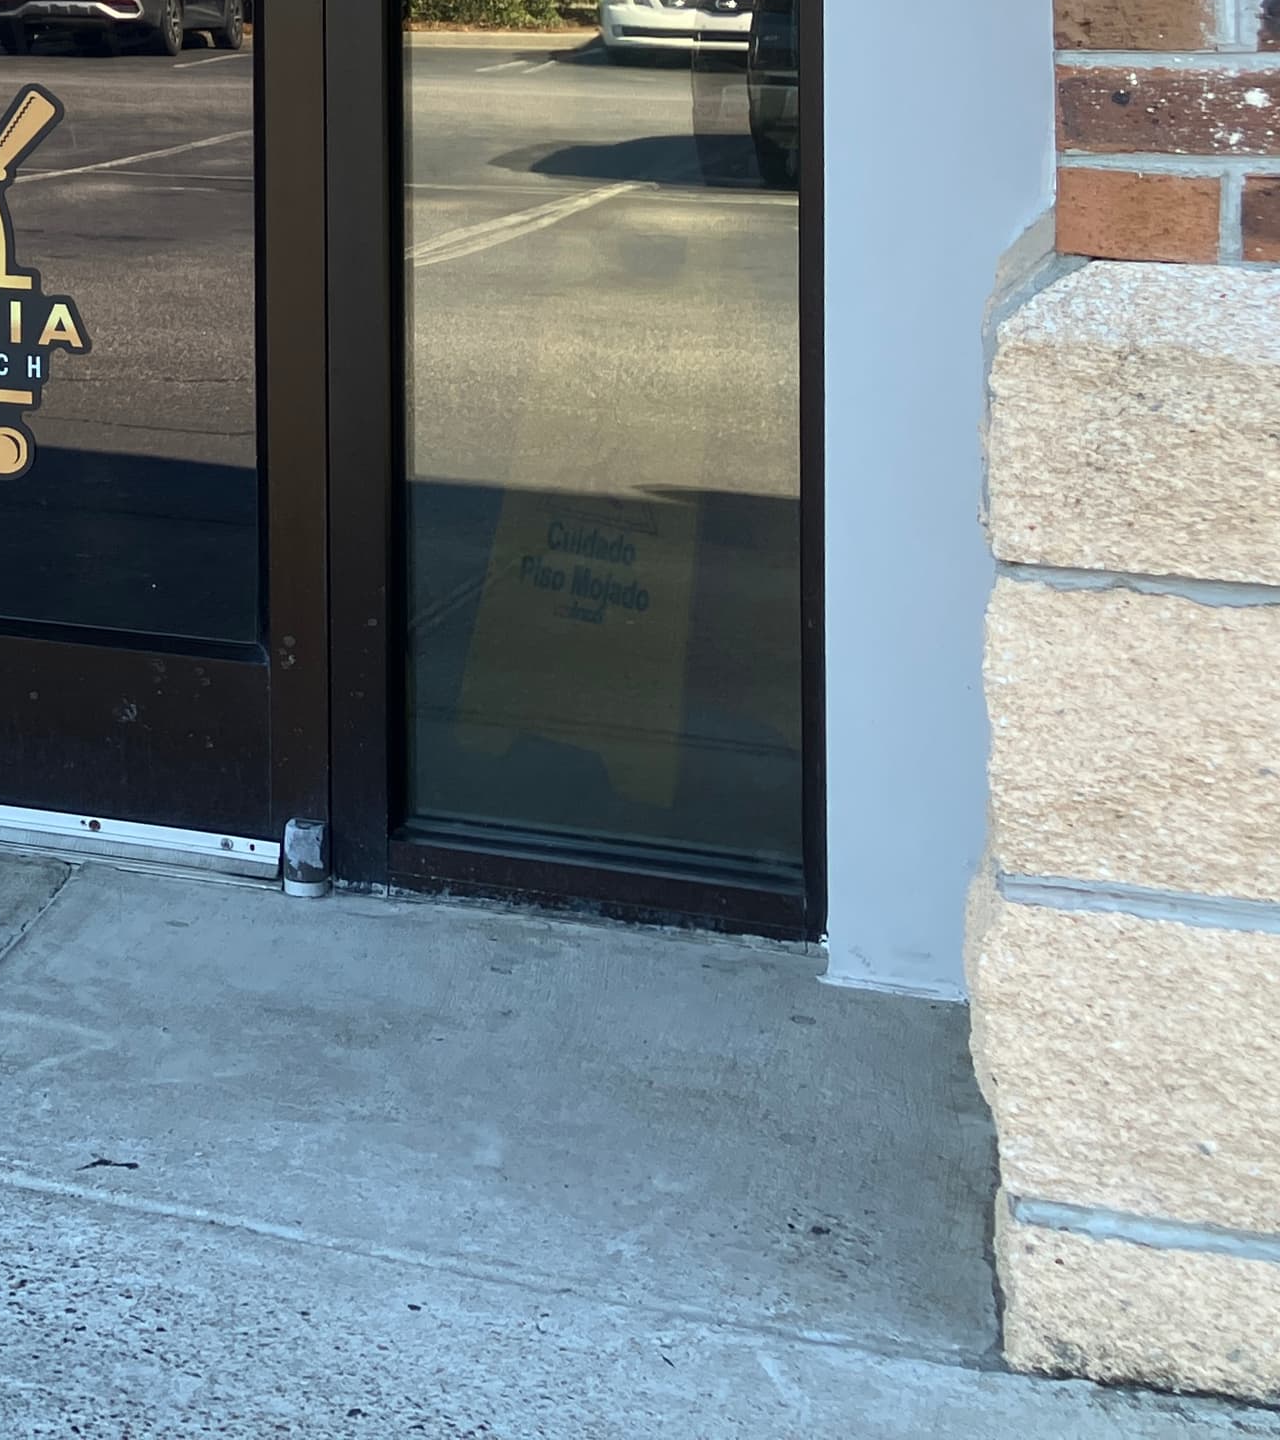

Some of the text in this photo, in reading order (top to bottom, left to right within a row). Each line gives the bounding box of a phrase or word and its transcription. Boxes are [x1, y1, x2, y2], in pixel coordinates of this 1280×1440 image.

[547, 520, 636, 565] Cuidado
[520, 554, 650, 613] Piso Mojado
